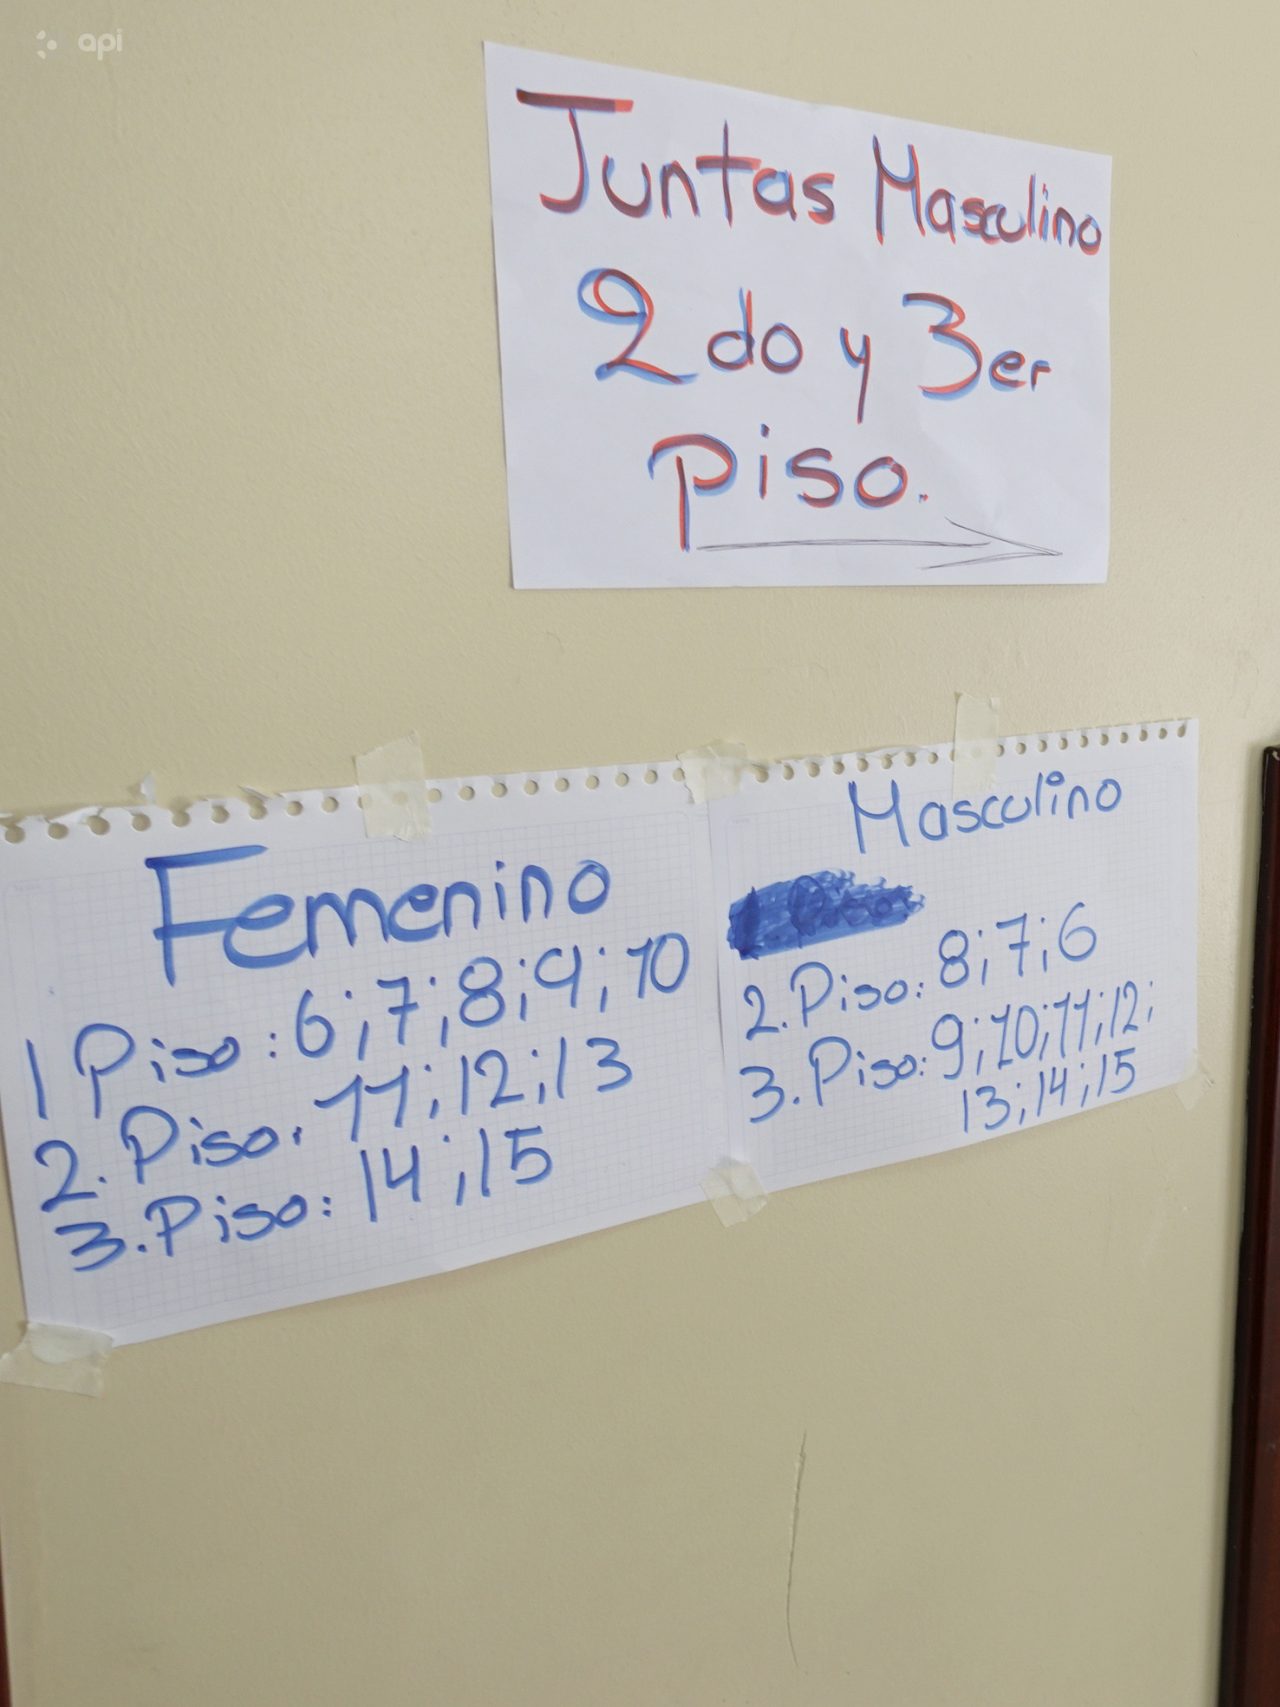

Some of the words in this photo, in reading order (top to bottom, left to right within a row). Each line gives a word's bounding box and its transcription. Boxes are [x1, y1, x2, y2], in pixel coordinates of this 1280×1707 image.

[515, 87, 836, 228] Juntas
[871, 133, 1104, 257] Masculino
[837, 324, 873, 425] y
[847, 769, 1124, 856] Masculino
[143, 843, 612, 987] Femenino
